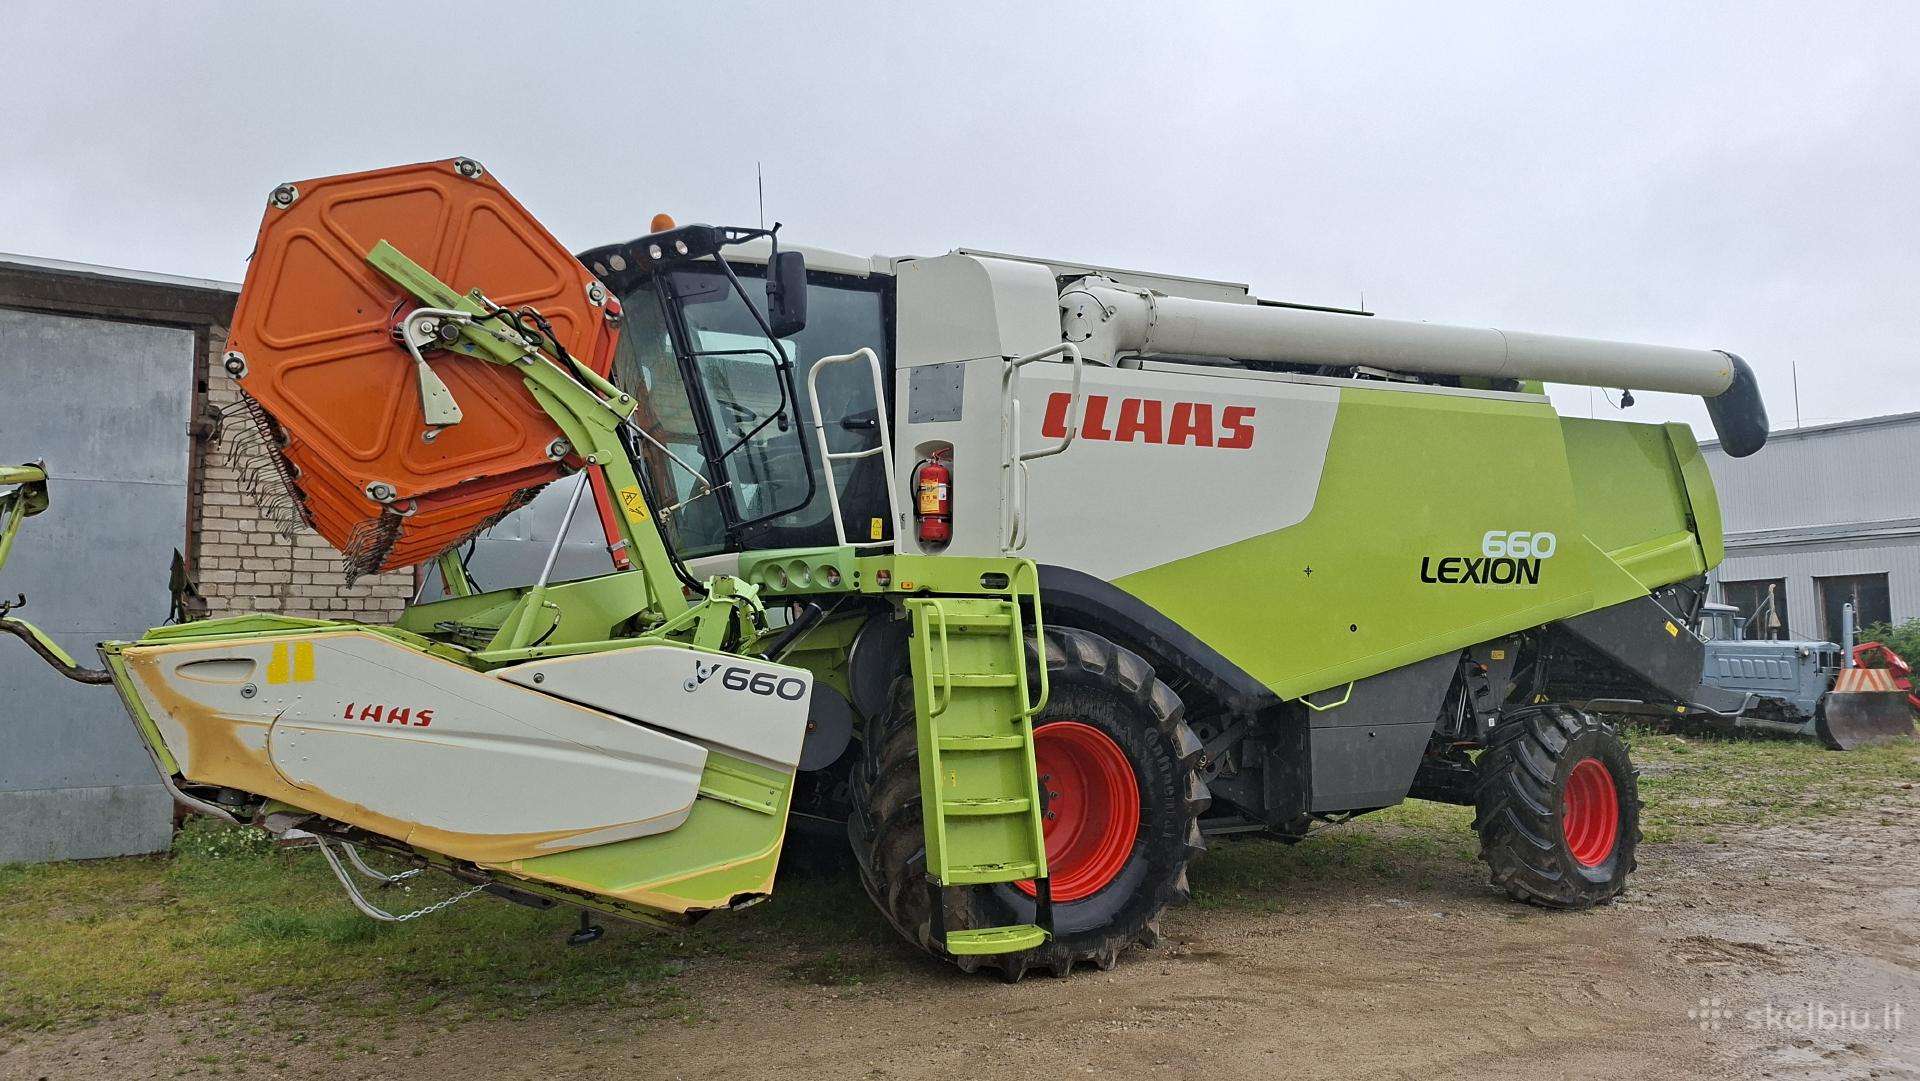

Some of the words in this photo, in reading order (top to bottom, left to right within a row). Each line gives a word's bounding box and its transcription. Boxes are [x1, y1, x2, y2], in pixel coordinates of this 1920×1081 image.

[1041, 392, 1256, 449] CLAAS
[1482, 530, 1557, 559] 660
[1420, 556, 1541, 584] LEXION
